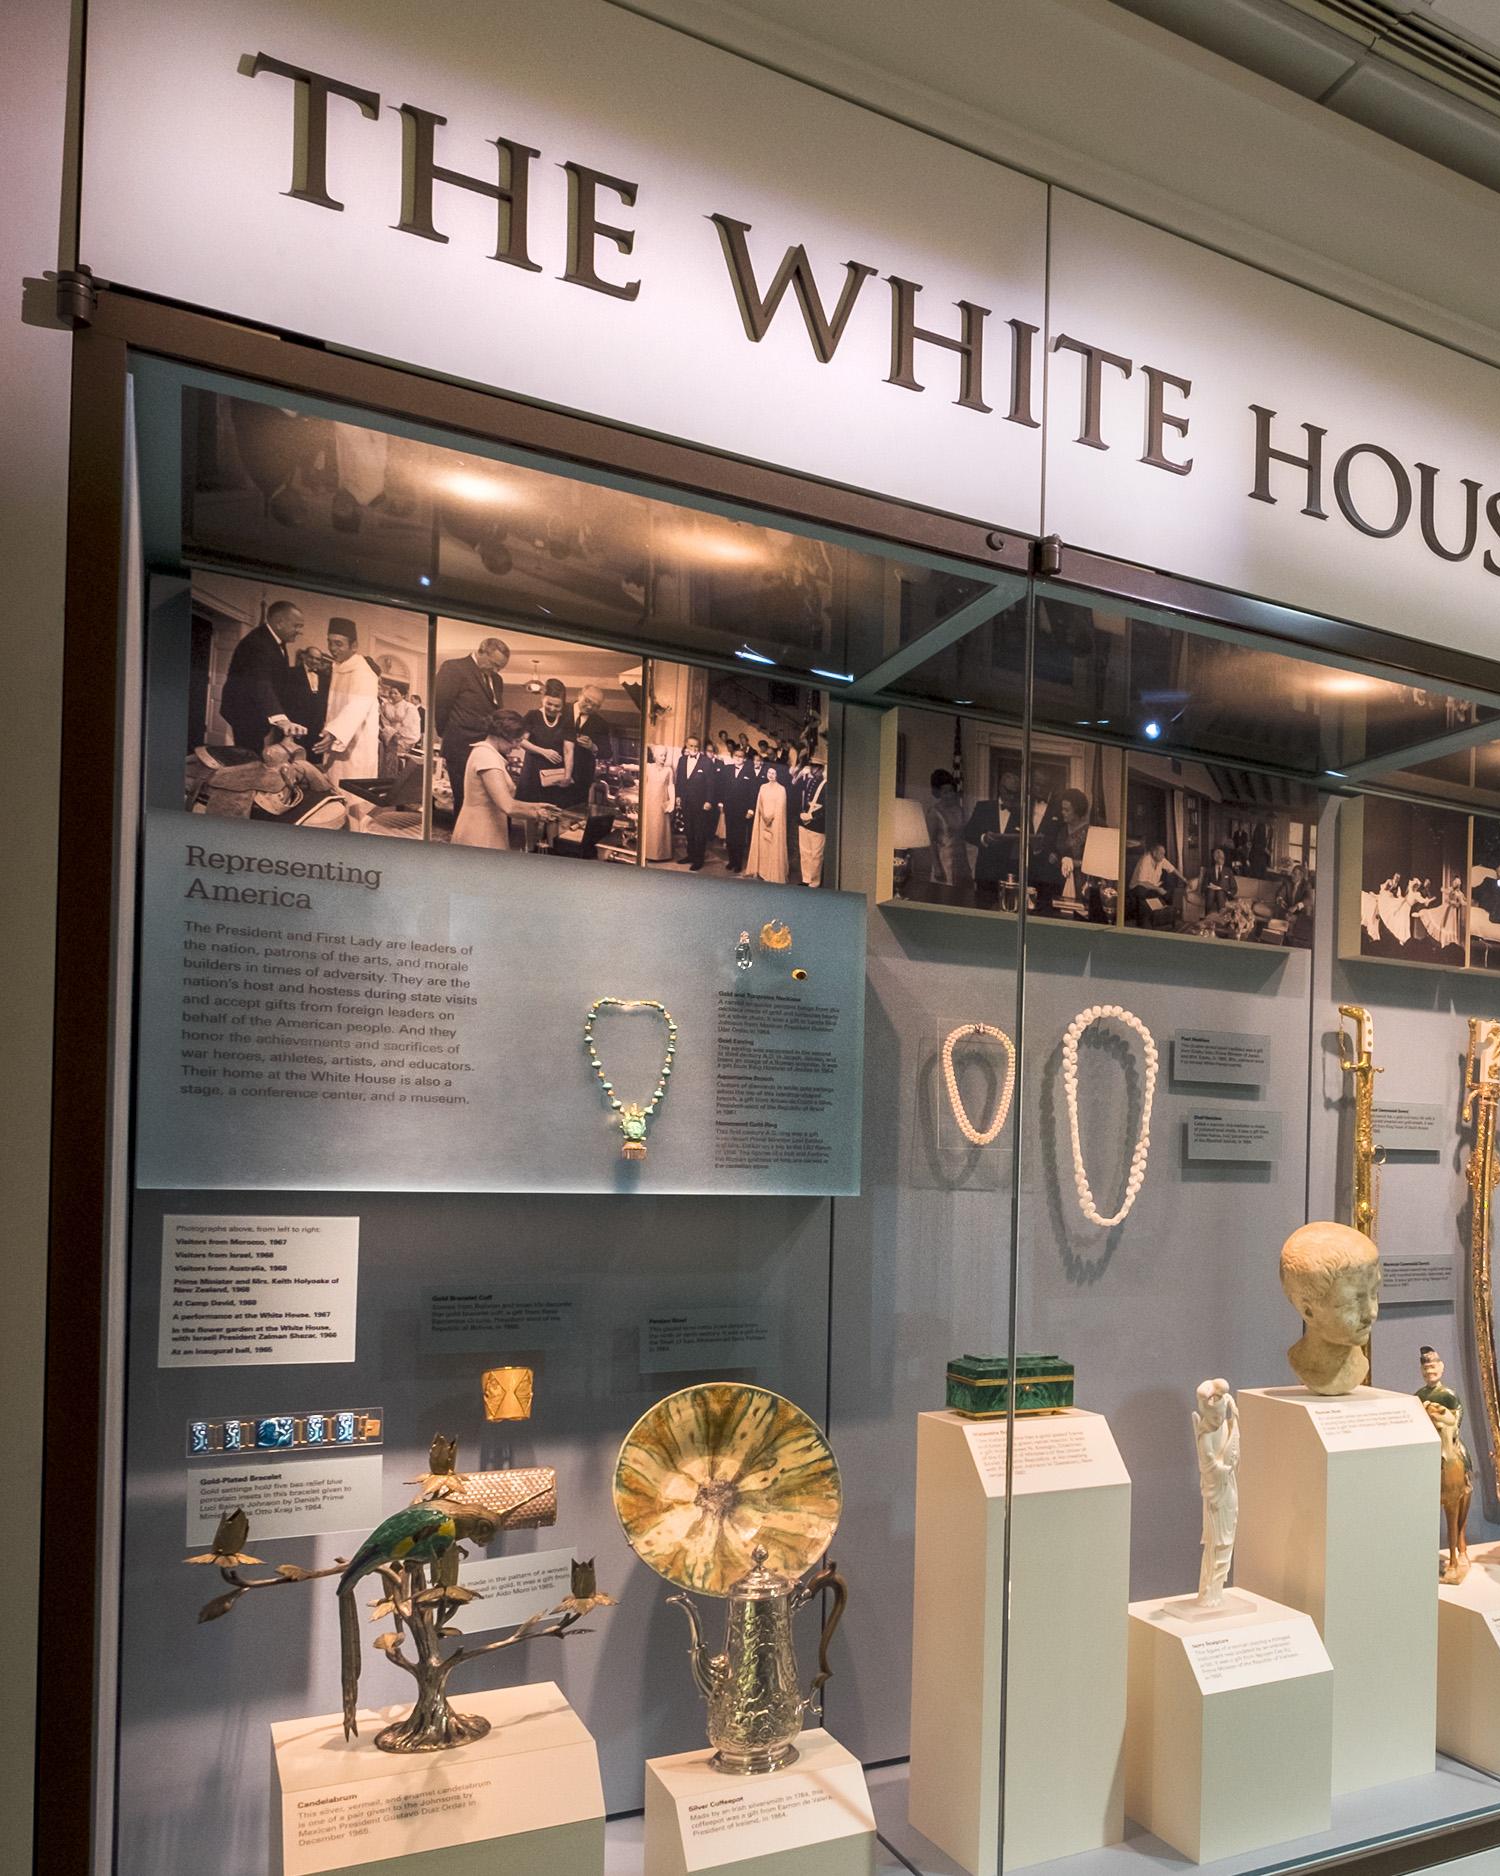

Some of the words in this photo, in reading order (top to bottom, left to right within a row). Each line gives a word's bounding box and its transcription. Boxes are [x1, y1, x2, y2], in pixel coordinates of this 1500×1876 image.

[243, 51, 641, 301] THE
[704, 213, 1194, 476] WHITE
[185, 845, 383, 889] Representing
[185, 877, 313, 910] America
[183, 921, 211, 933] The
[215, 923, 282, 939] President
[286, 929, 311, 941] and
[316, 932, 345, 944] First
[350, 935, 381, 950] Lady
[386, 940, 406, 949] are
[410, 940, 456, 953] leaders
[460, 944, 472, 955] of
[183, 940, 206, 951] the
[210, 942, 260, 956] nation,
[264, 946, 316, 962] patrons
[320, 950, 334, 961] of
[338, 952, 359, 963] the
[363, 954, 392, 966] arts,
[396, 956, 420, 967] and
[424, 958, 468, 971] morale
[183, 958, 241, 971] builders
[246, 963, 257, 973] in
[262, 964, 300, 976] times
[305, 967, 319, 977] of
[323, 968, 387, 984] adversity.
[391, 973, 422, 987] They
[427, 978, 446, 986] are
[450, 978, 470, 988] the
[183, 976, 239, 989] nation's
[243, 980, 273, 991] host
[278, 983, 304, 993] and
[308, 985, 360, 997] hostess
[364, 989, 406, 1003] during
[410, 992, 441, 1003] state
[445, 995, 477, 1005] visits
[182, 994, 209, 1005] and
[214, 996, 260, 1011] accept
[264, 999, 295, 1013] gifts
[300, 1001, 332, 1013] from
[336, 1004, 383, 1018] foreign
[388, 1007, 434, 1019] leaders
[182, 1011, 226, 1024] behalf
[231, 1014, 246, 1025] of
[249, 1016, 272, 1026] the
[275, 1017, 342, 1030] American
[346, 1021, 393, 1036] people.
[398, 1025, 425, 1035] And
[429, 1027, 456, 1039] they
[181, 1030, 224, 1041] honor
[229, 1033, 251, 1043] the
[256, 1034, 350, 1048] achievements
[355, 1039, 379, 1050] and
[383, 1041, 443, 1053] sacrifices
[447, 1044, 460, 1054] of
[213, 1050, 265, 1062] heroes,
[269, 1053, 327, 1065] athletes,
[331, 1056, 376, 1067] artists,
[380, 1058, 404, 1068] and
[408, 1059, 474, 1071] educators.
[180, 1067, 218, 1077] Their
[222, 1068, 263, 1079] home
[267, 1070, 280, 1079] at
[284, 1071, 306, 1080] the
[310, 1072, 350, 1082] White
[354, 1074, 395, 1084] House
[400, 1076, 410, 1085] is
[414, 1077, 440, 1086] also
[180, 1085, 223, 1098] stage,
[241, 1087, 317, 1099] conference
[321, 1090, 365, 1102] center,
[370, 1092, 394, 1101] and
[410, 1094, 468, 1104] museum.
[250, 1474, 282, 1482] Bracelet
[298, 1794, 357, 1809] Candelabrum
[420, 1794, 460, 1807] Johnsons
[340, 1817, 380, 1829] President
